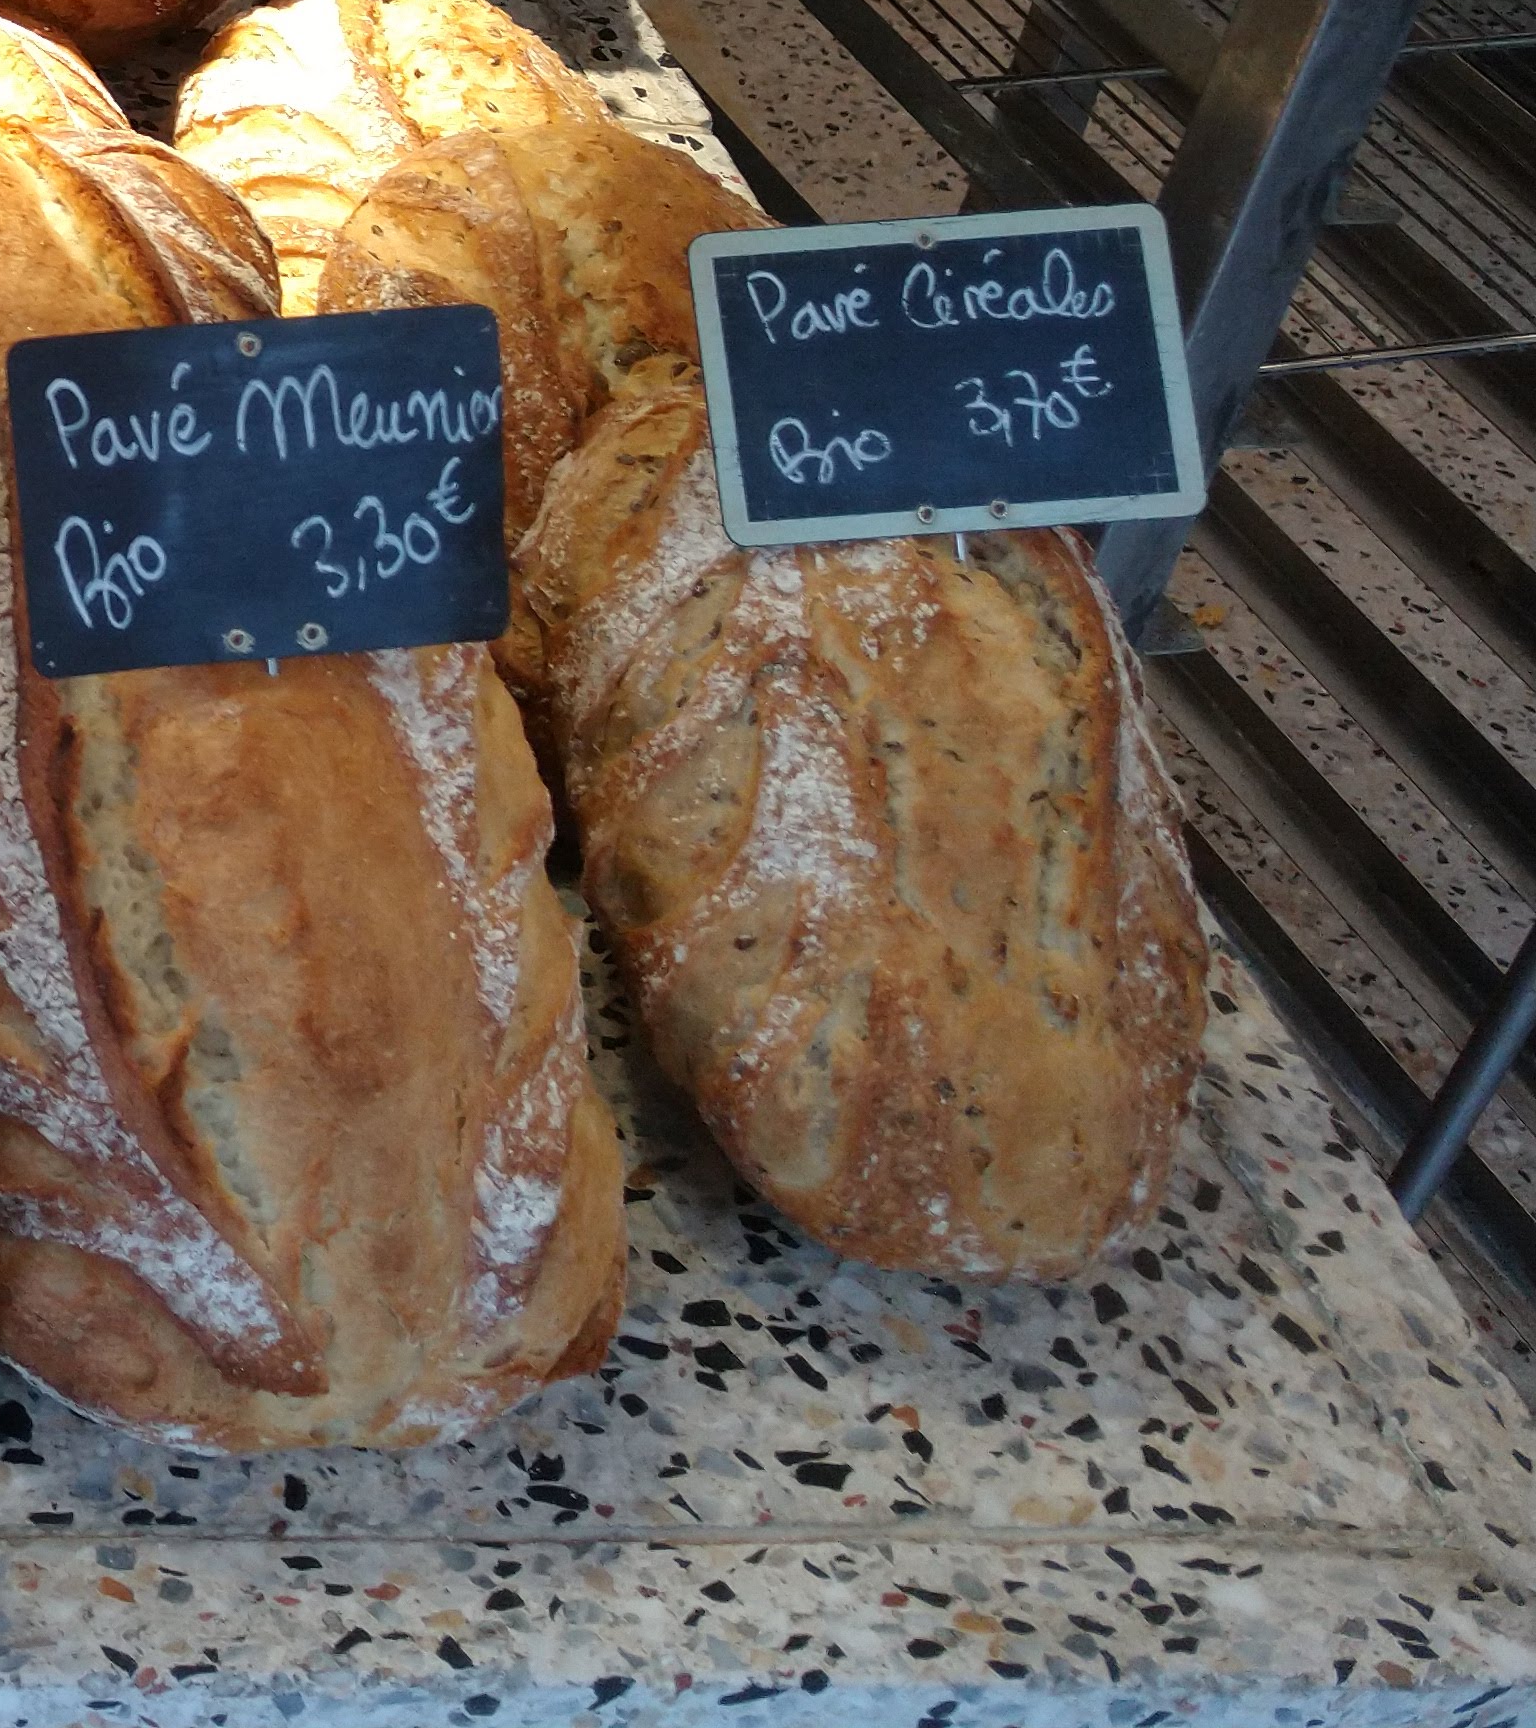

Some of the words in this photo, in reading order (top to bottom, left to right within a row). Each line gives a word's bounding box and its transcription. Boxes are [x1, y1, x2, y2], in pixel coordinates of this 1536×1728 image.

[746, 263, 880, 345] Pavé
[901, 247, 1116, 329] Céréales
[46, 361, 213, 470] Pavé
[768, 409, 892, 485] Bio
[54, 515, 168, 630] Bio
